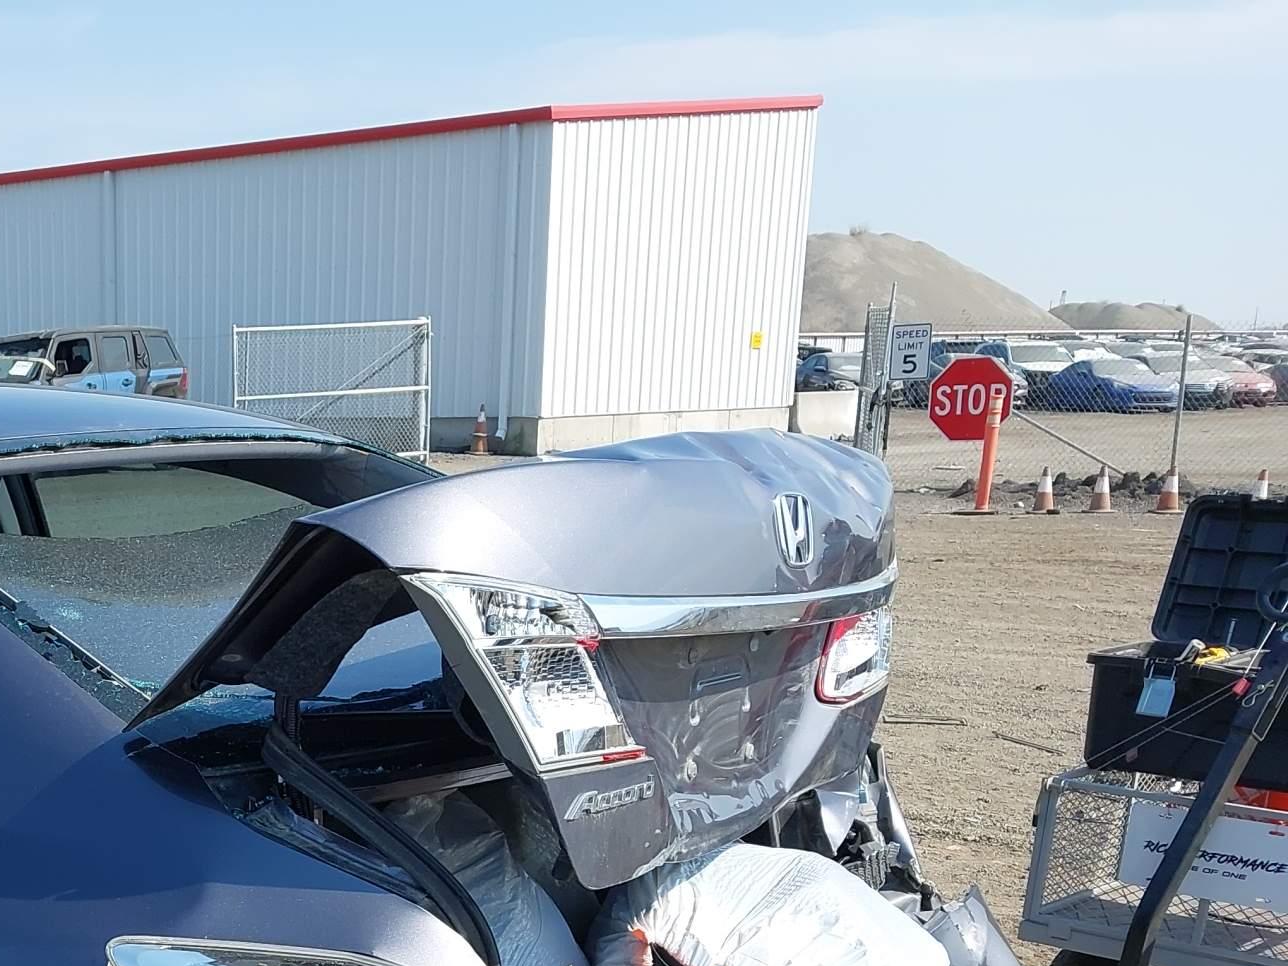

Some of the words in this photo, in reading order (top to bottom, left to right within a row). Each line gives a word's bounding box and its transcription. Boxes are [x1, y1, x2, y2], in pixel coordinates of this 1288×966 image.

[895, 329, 928, 339] SPEED
[897, 341, 925, 351] LIMIT
[902, 354, 918, 374] 5
[934, 383, 1008, 416] STOP
[563, 774, 655, 820] Accord
[1222, 871, 1248, 880] ONE
